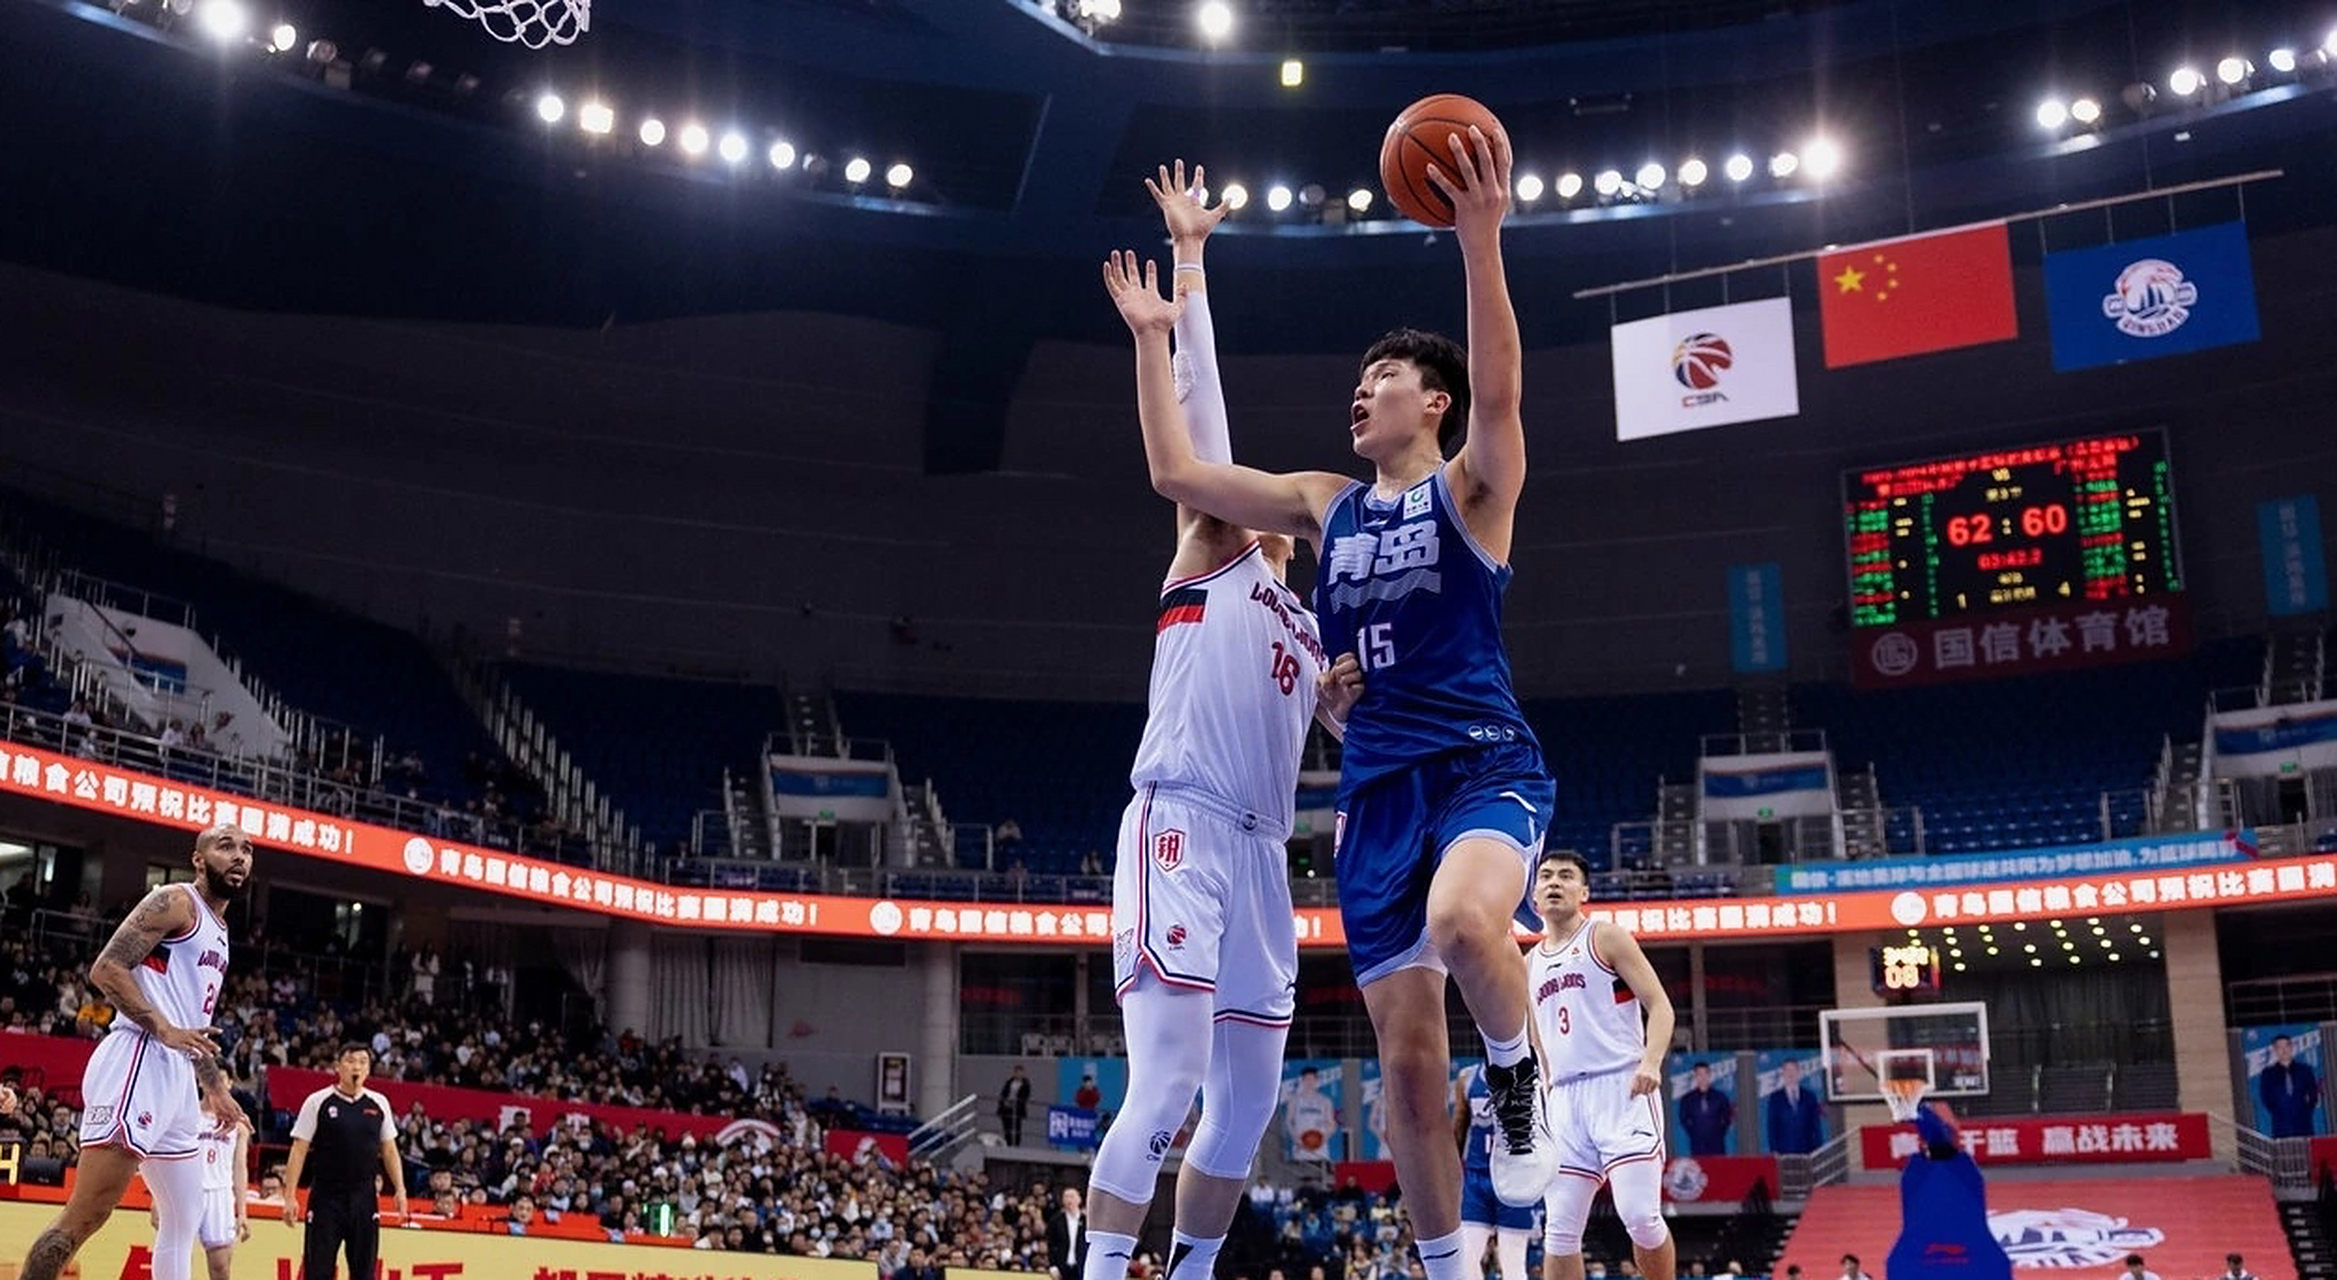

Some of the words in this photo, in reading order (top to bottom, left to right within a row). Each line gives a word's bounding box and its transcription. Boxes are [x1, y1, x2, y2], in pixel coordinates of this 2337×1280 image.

[1948, 514, 1993, 546] 62
[2022, 504, 2067, 537] 60
[1327, 519, 1440, 587] 青岛
[1357, 622, 1396, 673] 15
[1933, 605, 2169, 669] 国信体育馆
[1271, 641, 1301, 697] 16
[0, 752, 354, 854] 粮食公司预祝比赛圆满成功！
[910, 907, 1113, 936] 青岛国信粮食公司
[1559, 1006, 1570, 1035] 3
[207, 1151, 216, 1165] 8
[2043, 1123, 2177, 1155] 赢战未来
